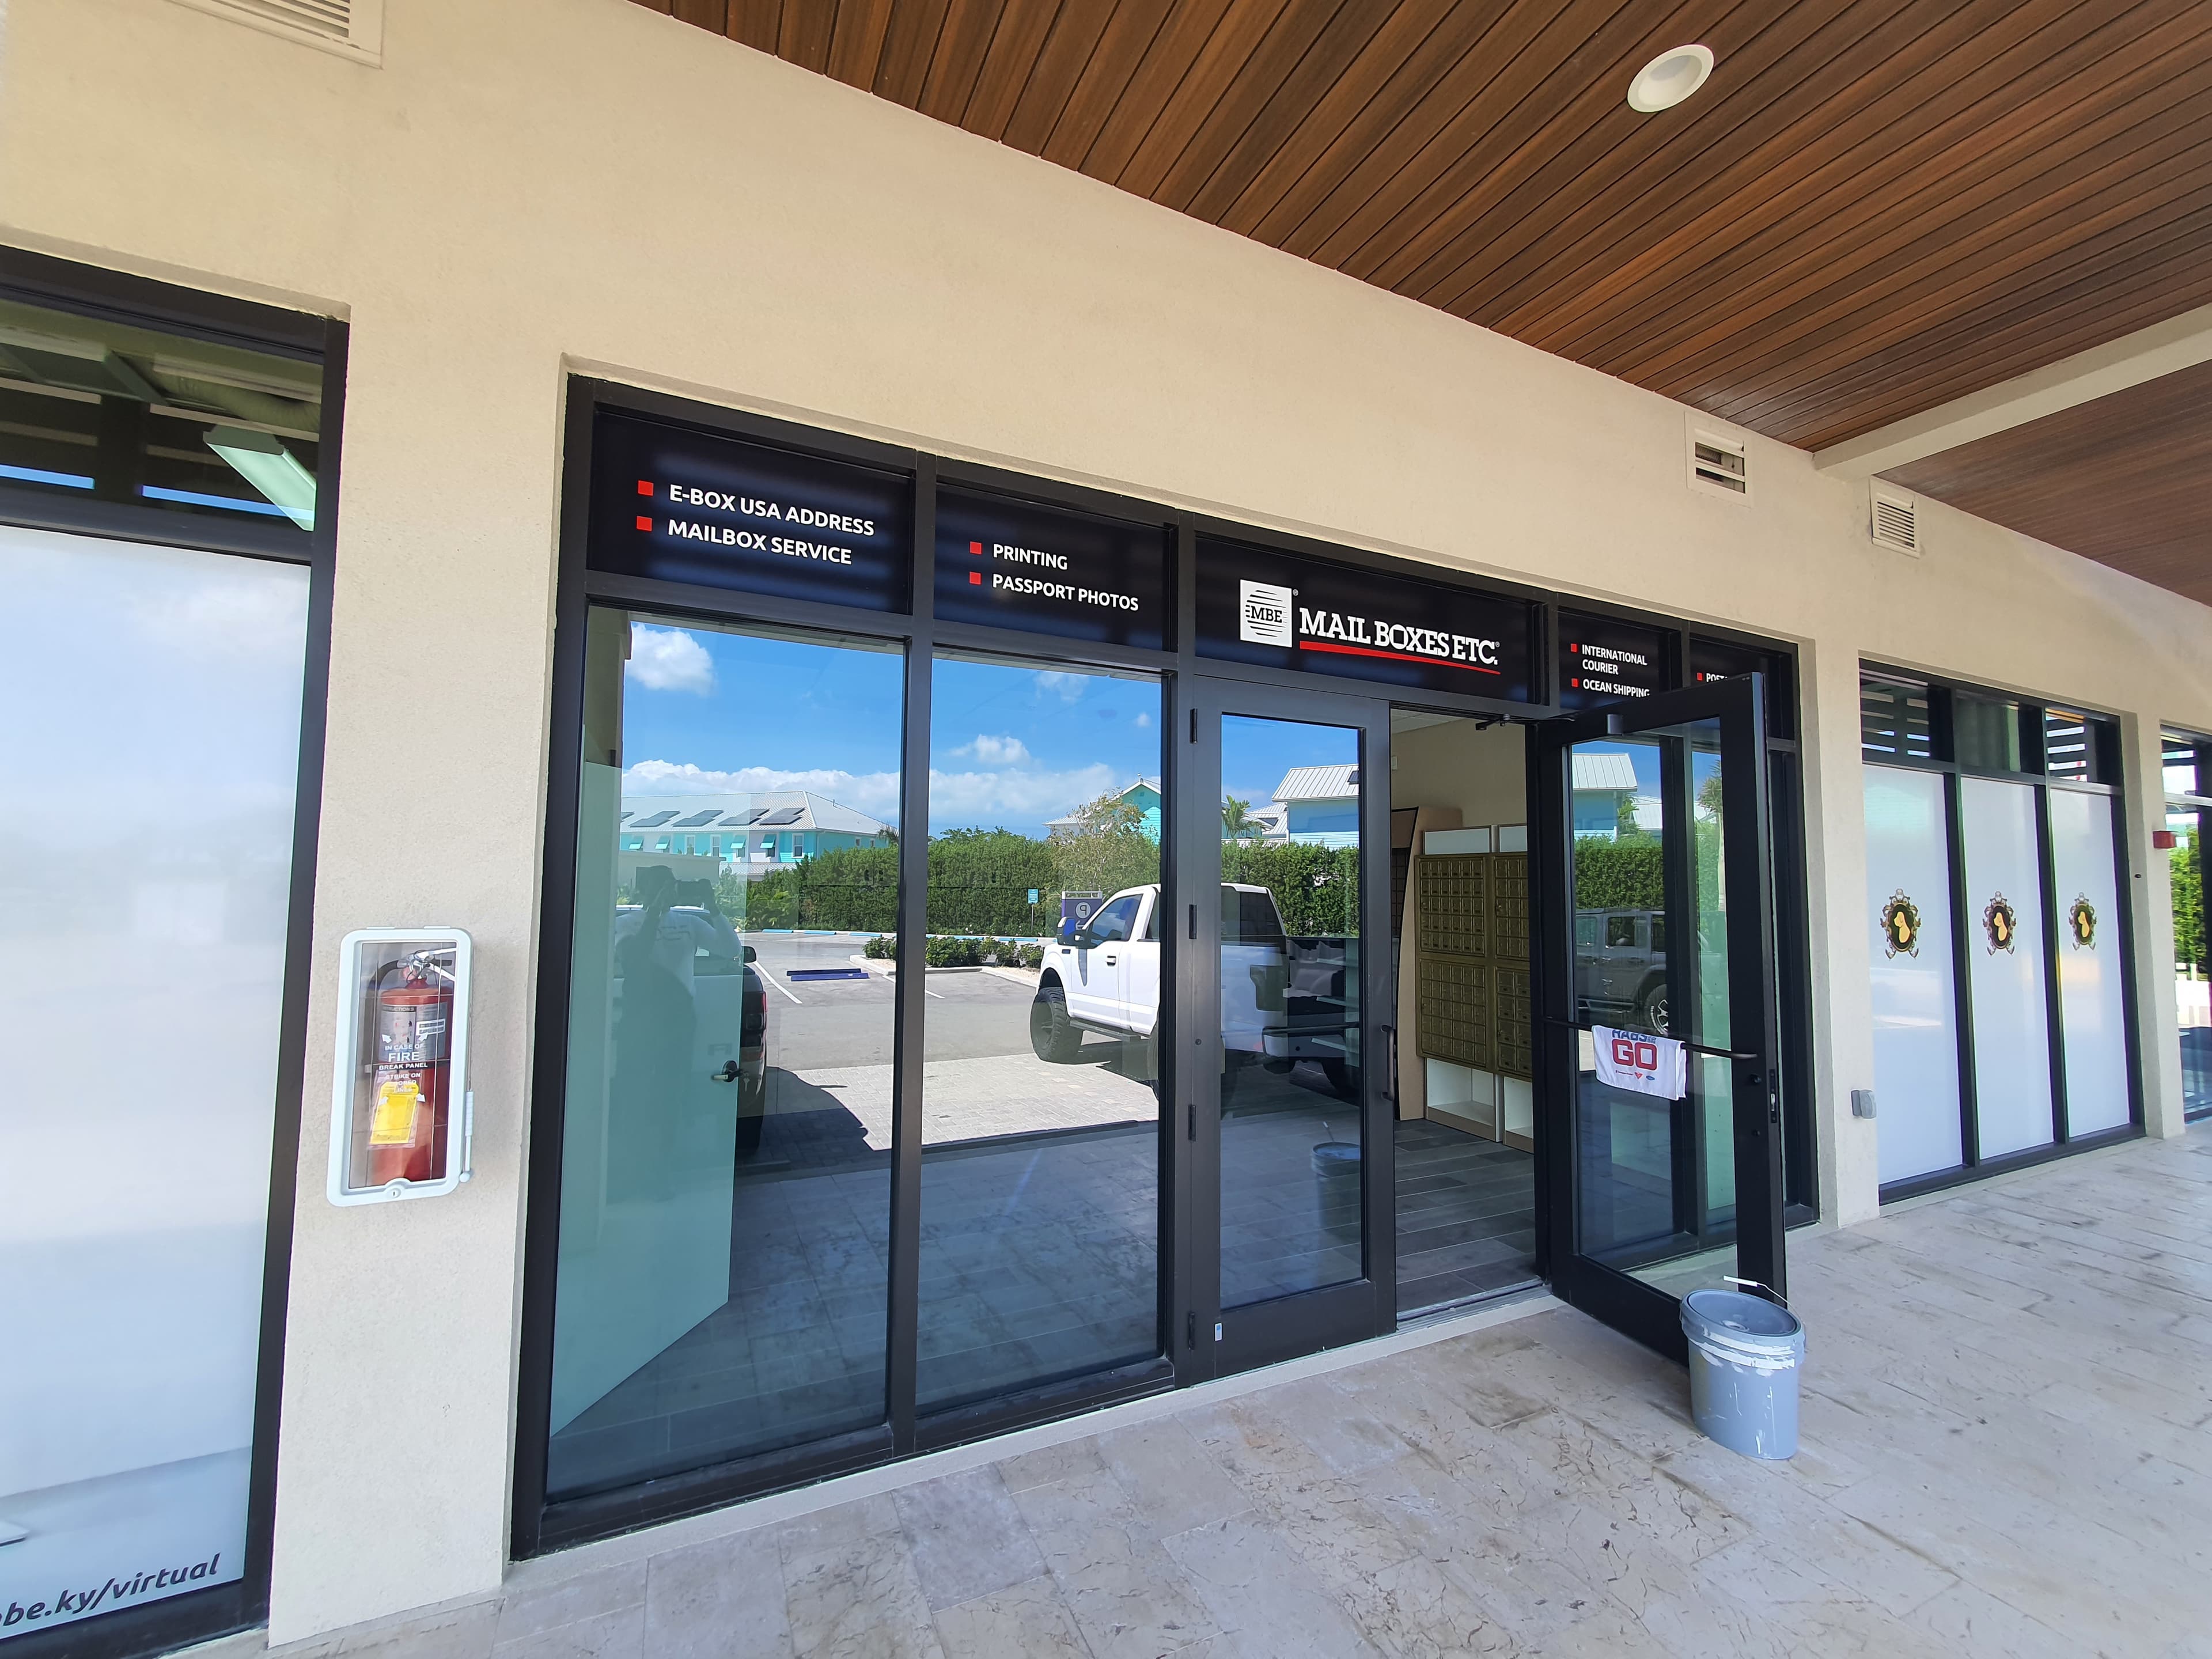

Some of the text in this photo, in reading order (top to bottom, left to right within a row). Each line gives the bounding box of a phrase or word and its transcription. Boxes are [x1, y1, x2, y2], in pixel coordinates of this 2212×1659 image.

[669, 484, 875, 536] E-BOX USA ADDRESS
[668, 519, 853, 565] MAILBOX SERVICE
[993, 543, 1068, 570] PRINTING
[992, 573, 1139, 611] PASSPORT PHOTOS
[1251, 605, 1283, 623] MBE
[1299, 607, 1371, 645] MAIL
[1374, 620, 1450, 657] BOXES
[1582, 644, 1647, 666] INTERNATIONAL
[1582, 659, 1619, 675] COURIER
[1582, 679, 1612, 693] OCEAN
[388, 1051, 420, 1062] FIRE
[1612, 1039, 1657, 1071] GO
[0, 1552, 221, 1626] be.ky/virtual
